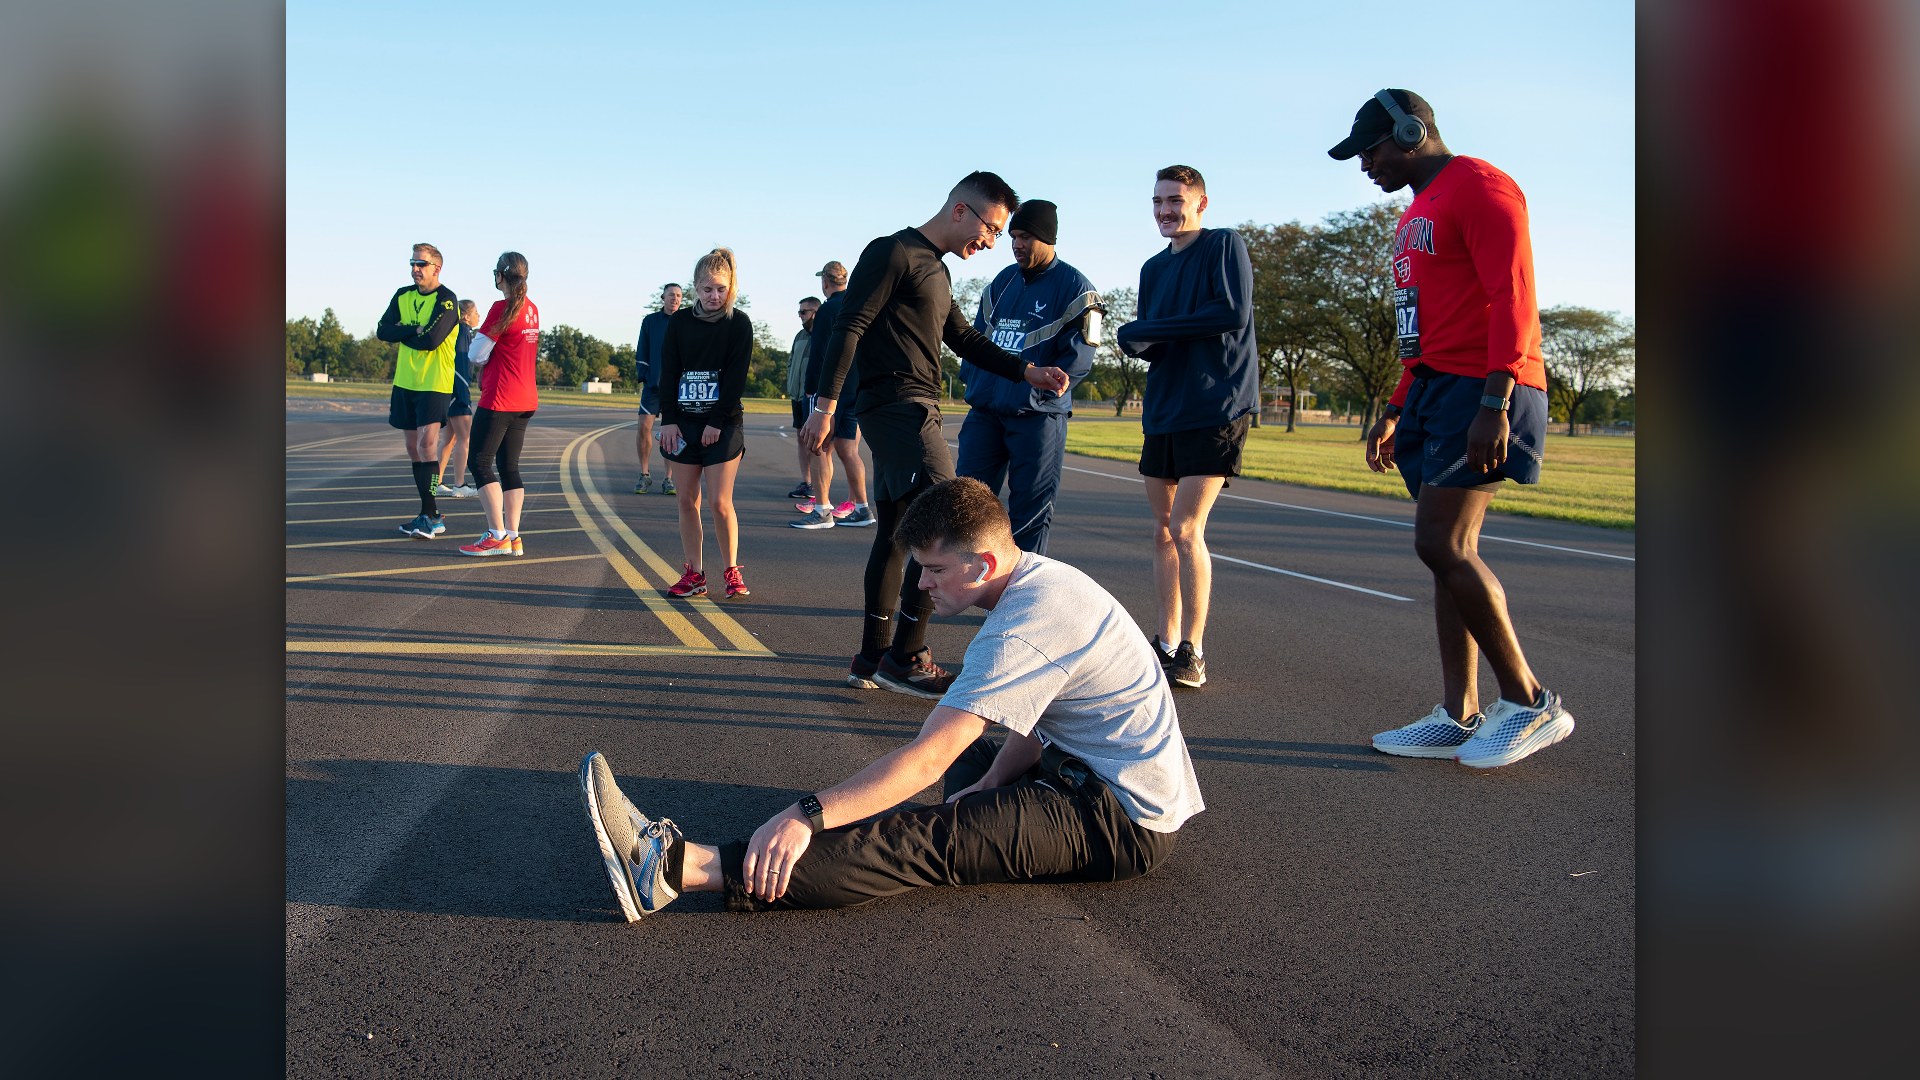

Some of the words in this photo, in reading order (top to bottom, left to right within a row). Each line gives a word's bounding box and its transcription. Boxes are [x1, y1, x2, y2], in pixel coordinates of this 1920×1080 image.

[1394, 217, 1435, 257] AYTON
[1395, 306, 1416, 334] 97
[992, 330, 1025, 348] 1997
[680, 382, 717, 399] 1997
